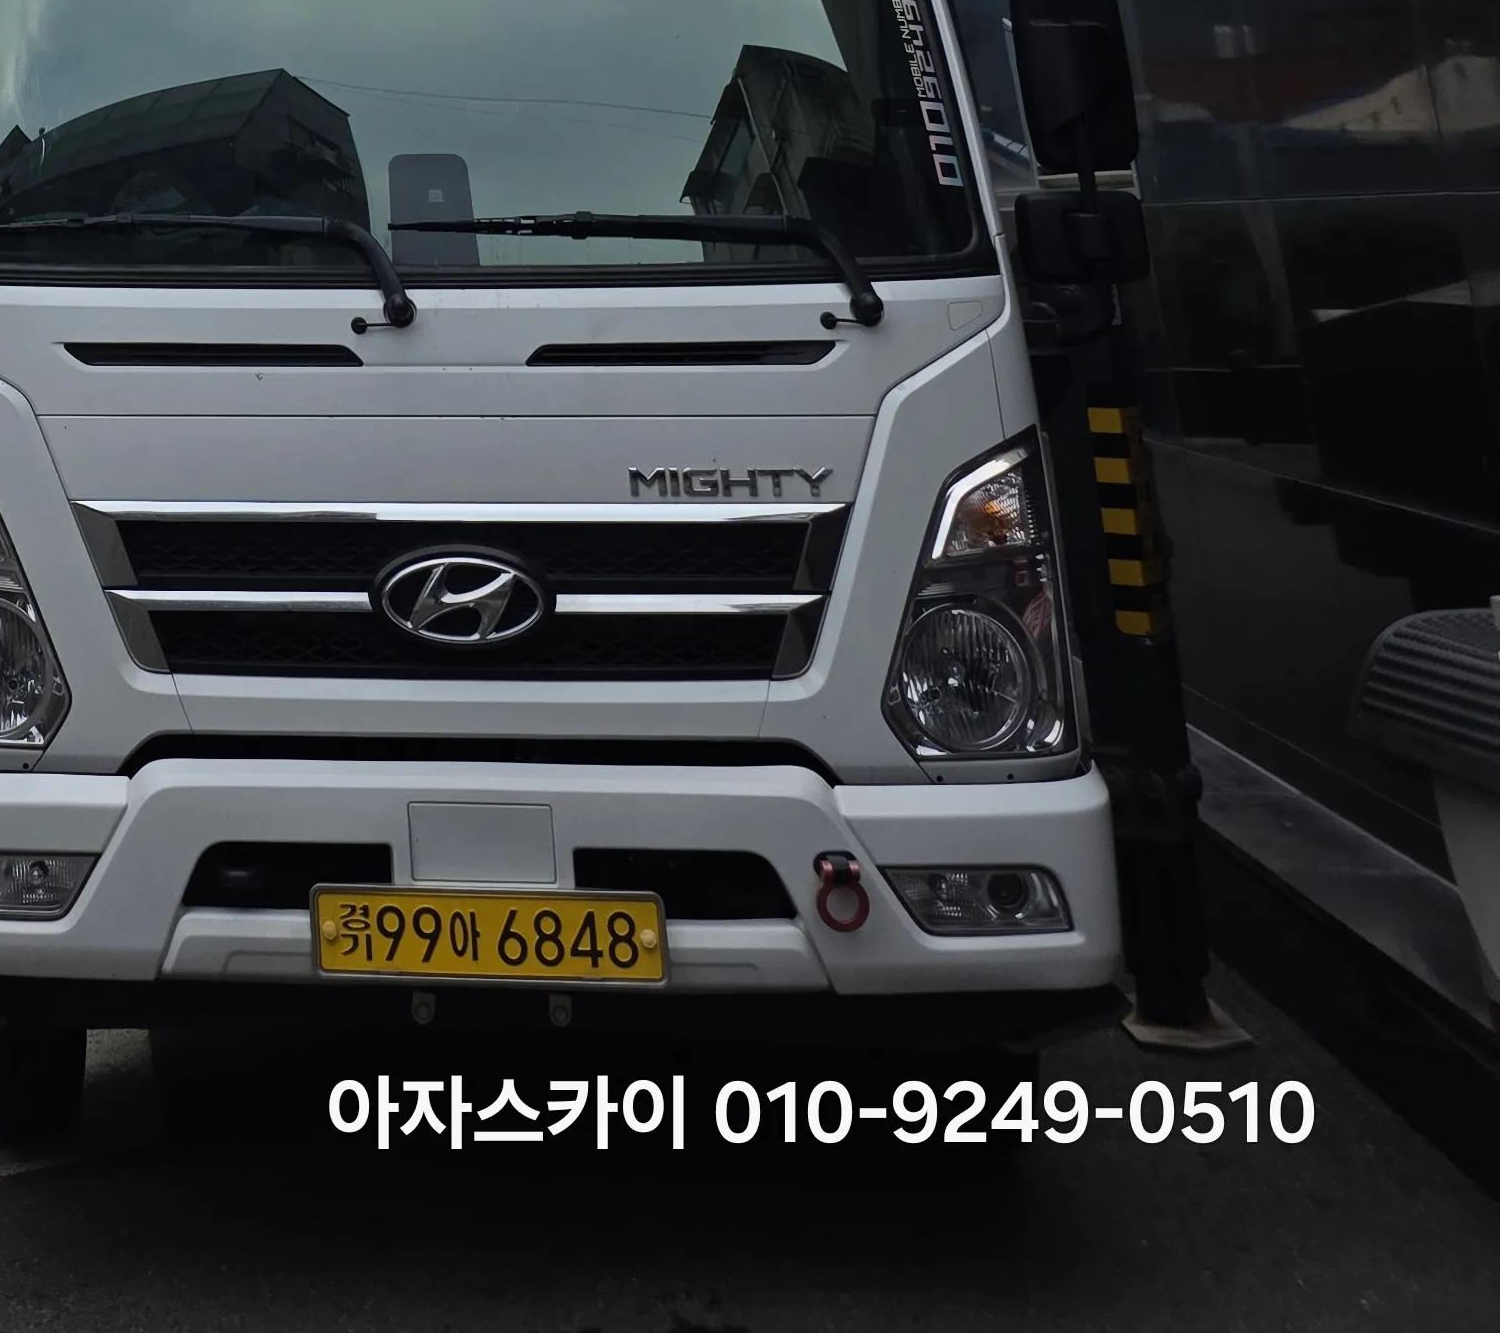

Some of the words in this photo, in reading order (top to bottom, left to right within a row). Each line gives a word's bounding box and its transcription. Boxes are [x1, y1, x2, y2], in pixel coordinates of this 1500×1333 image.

[903, 42, 925, 99] MOBILE
[627, 467, 834, 498] MIGHTY
[338, 903, 372, 962] 경기
[375, 904, 481, 963] 99아
[496, 908, 640, 970] 6848
